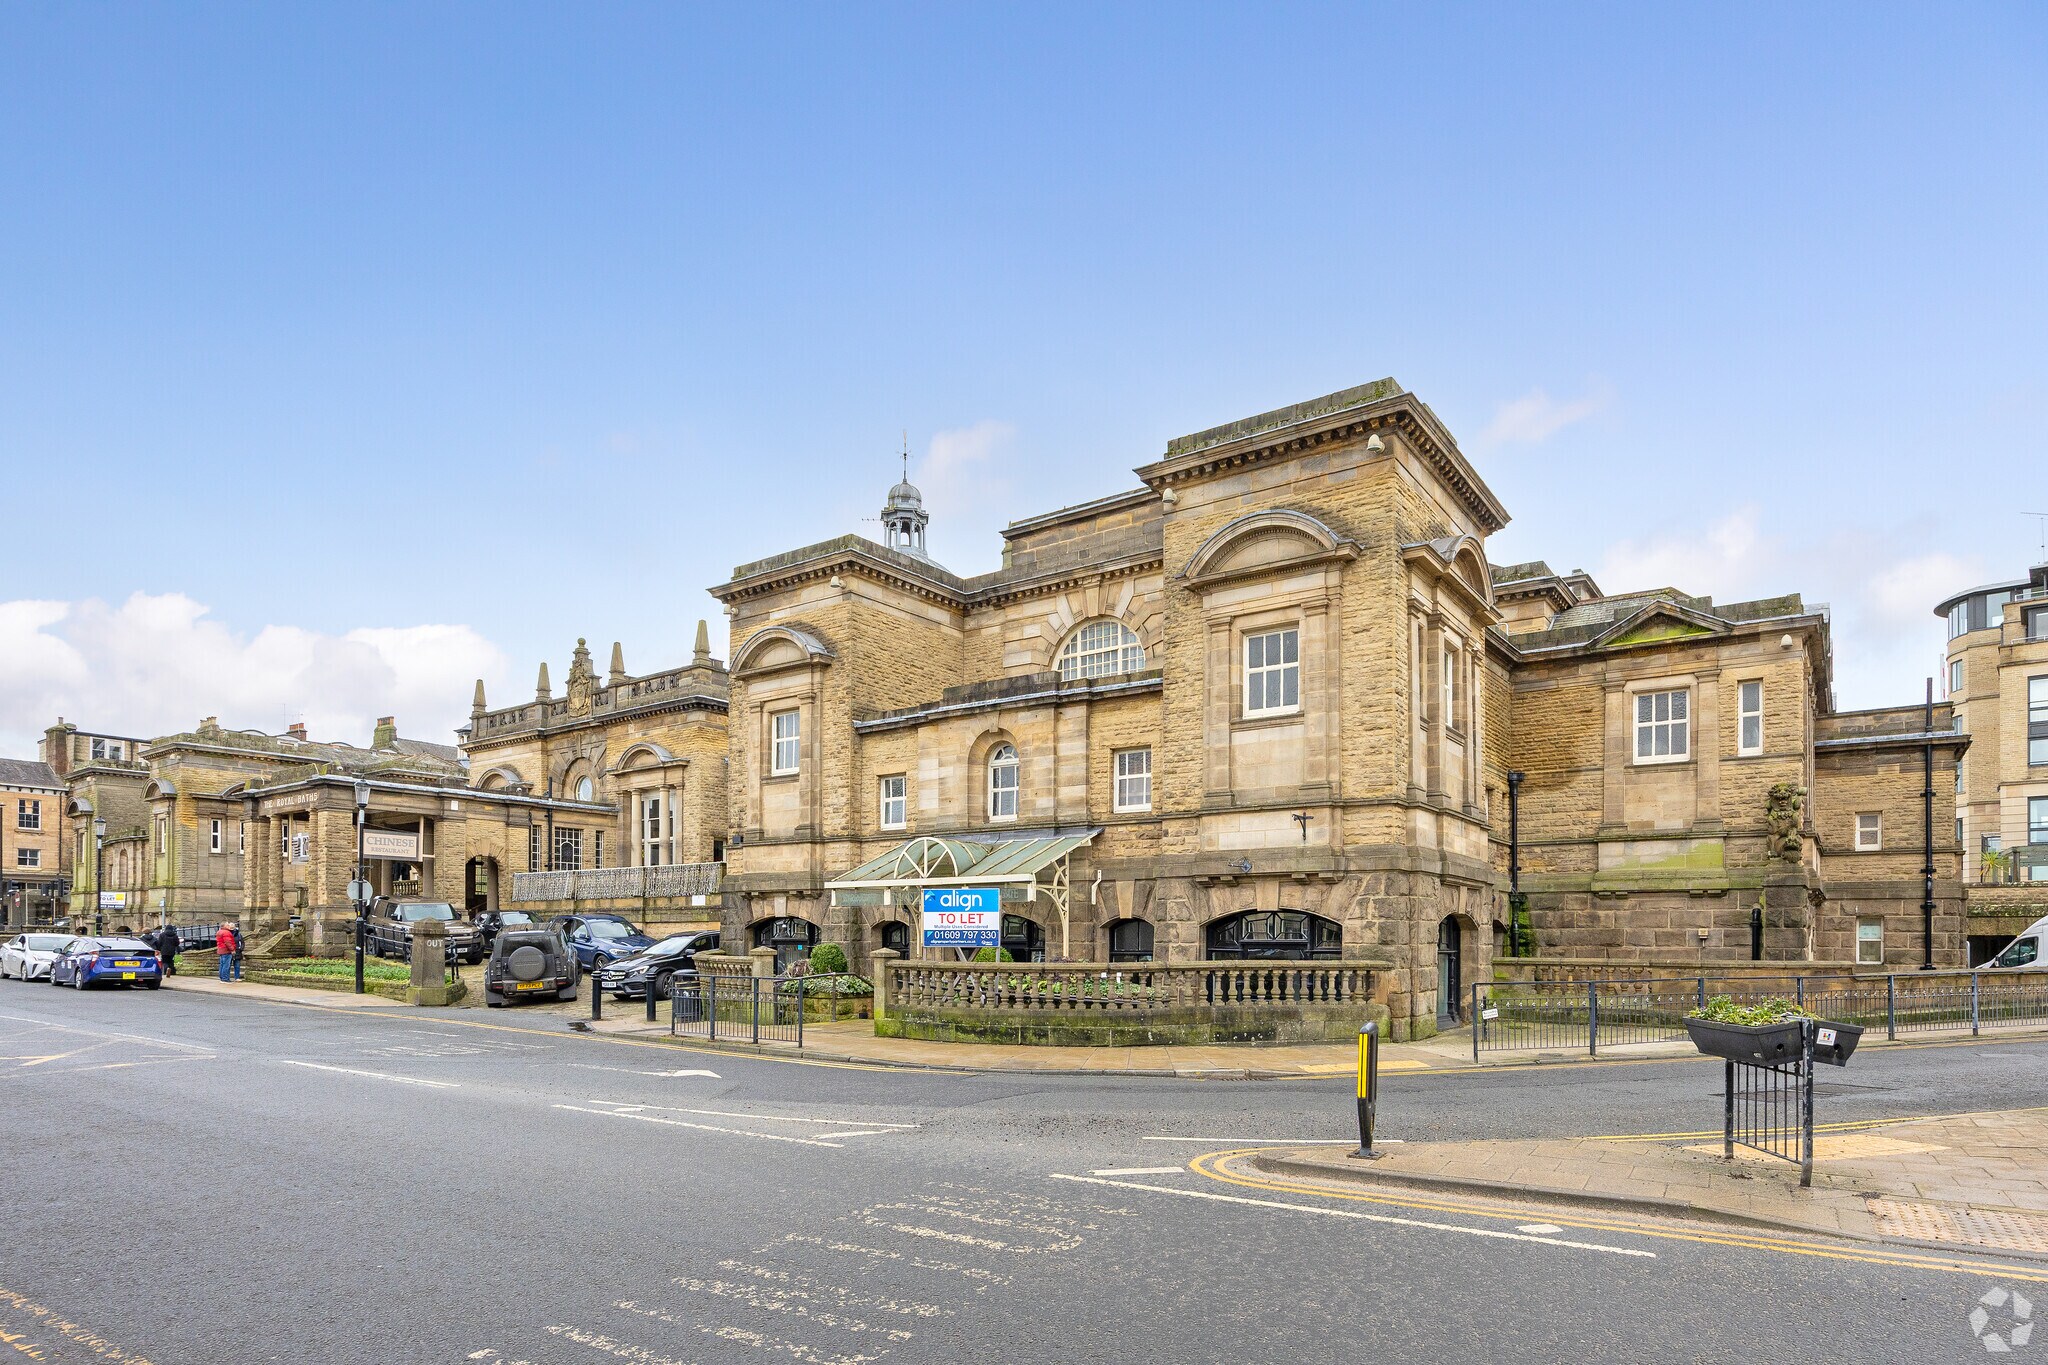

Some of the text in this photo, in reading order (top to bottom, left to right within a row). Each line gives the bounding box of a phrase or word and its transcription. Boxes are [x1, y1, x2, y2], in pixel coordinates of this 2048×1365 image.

[264, 793, 318, 809] THE ROYAL BATHS
[366, 836, 415, 848] CHINESE
[940, 890, 983, 912] align
[938, 913, 984, 924] TO LET
[934, 931, 997, 939] 01609 797 330
[426, 939, 444, 947] OUT
